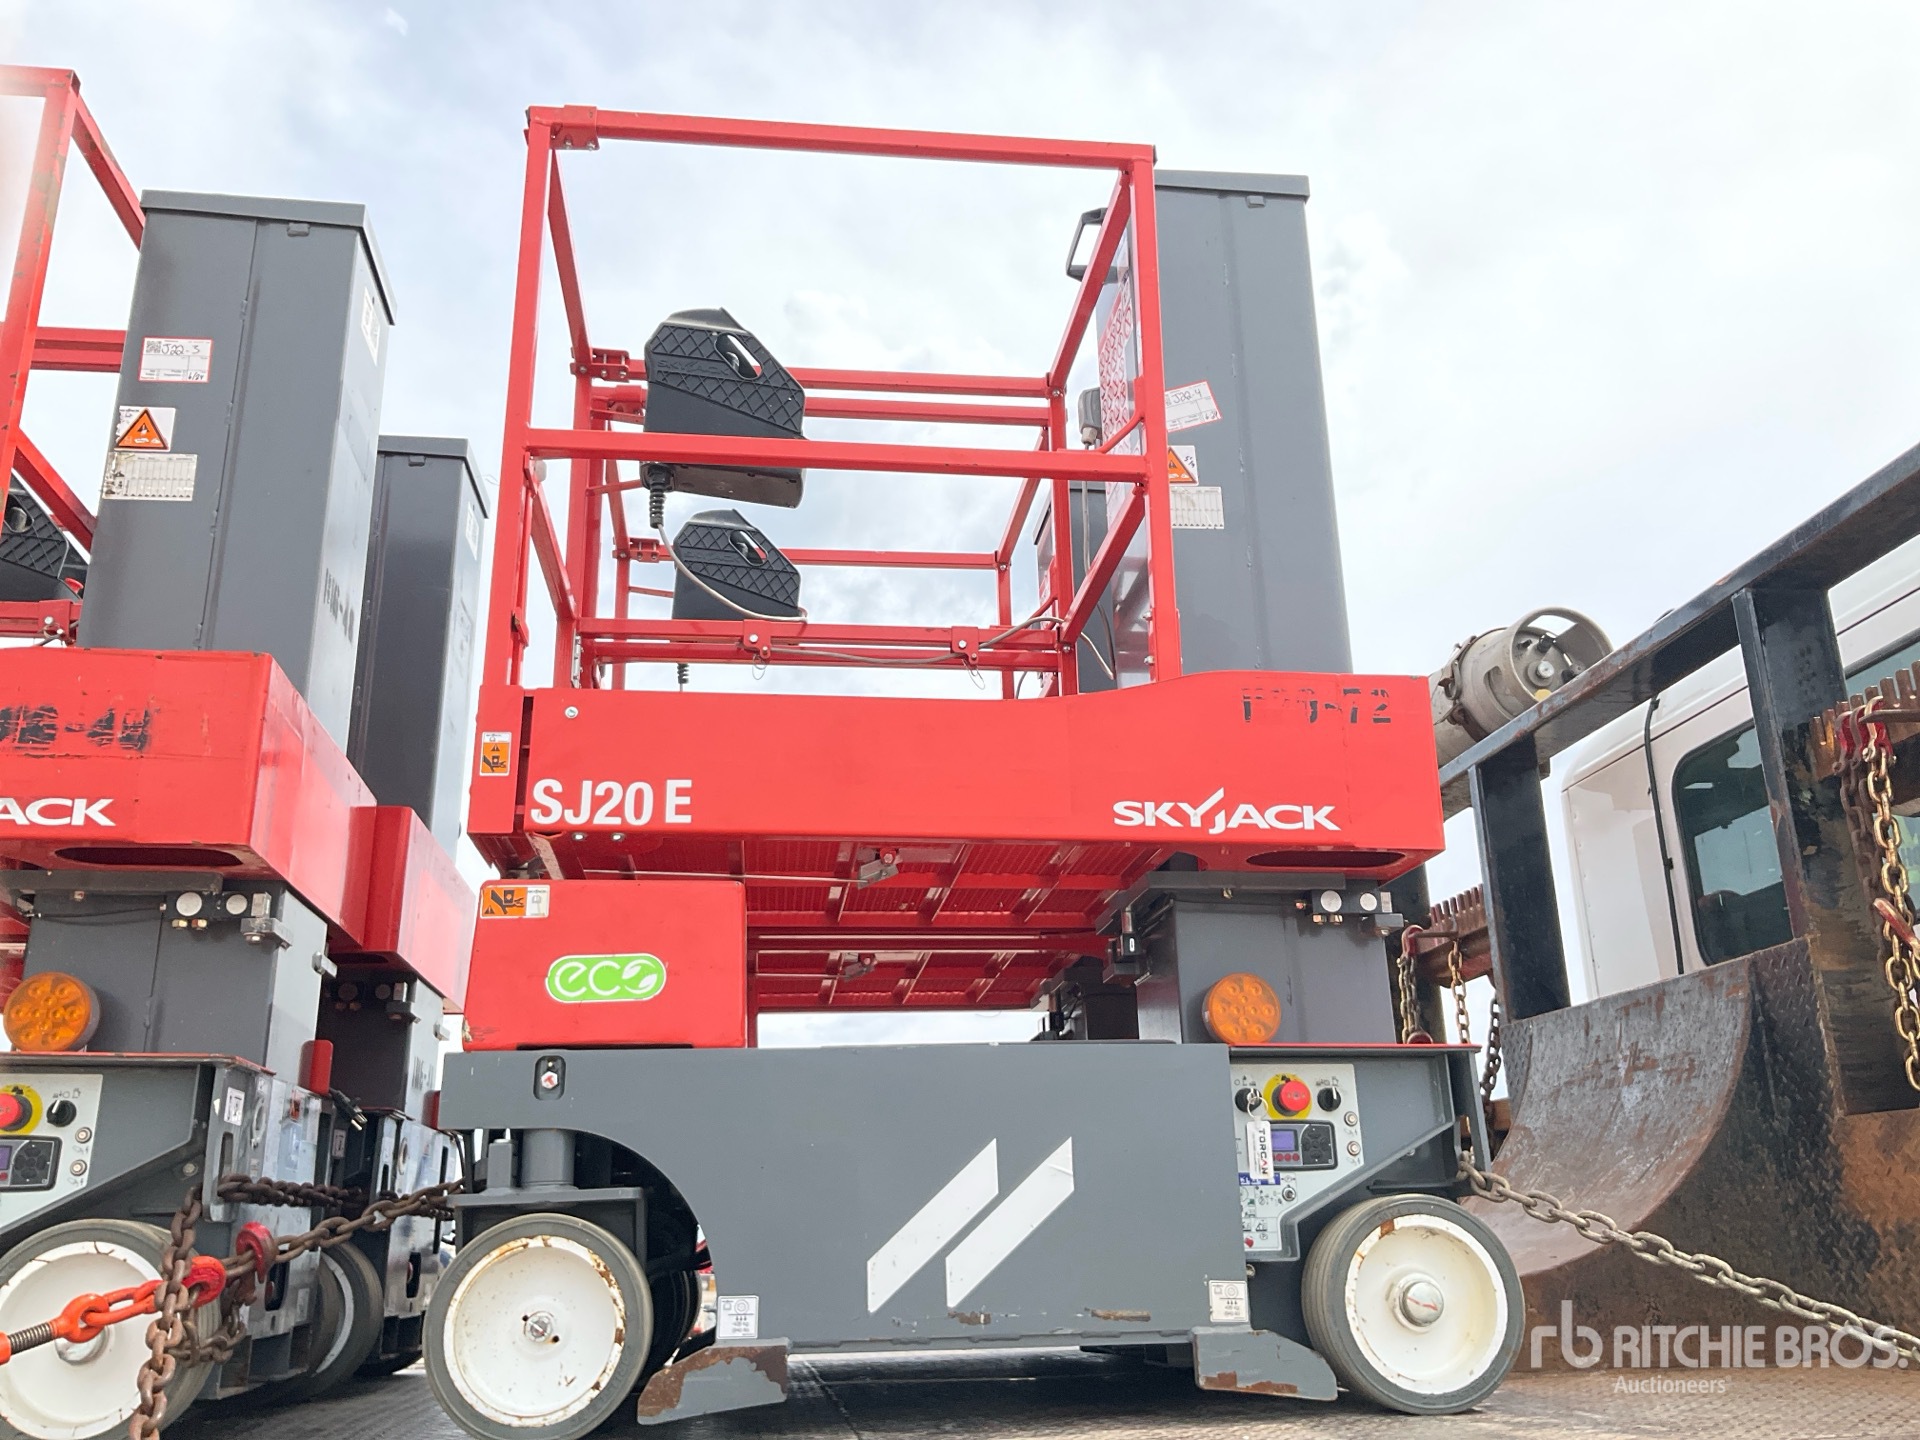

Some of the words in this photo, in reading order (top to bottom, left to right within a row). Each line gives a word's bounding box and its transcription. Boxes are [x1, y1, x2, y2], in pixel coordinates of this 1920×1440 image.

[1112, 787, 1342, 834] SKYJACK
[554, 958, 658, 998] eco
[1258, 1127, 1269, 1175] TORCAN
